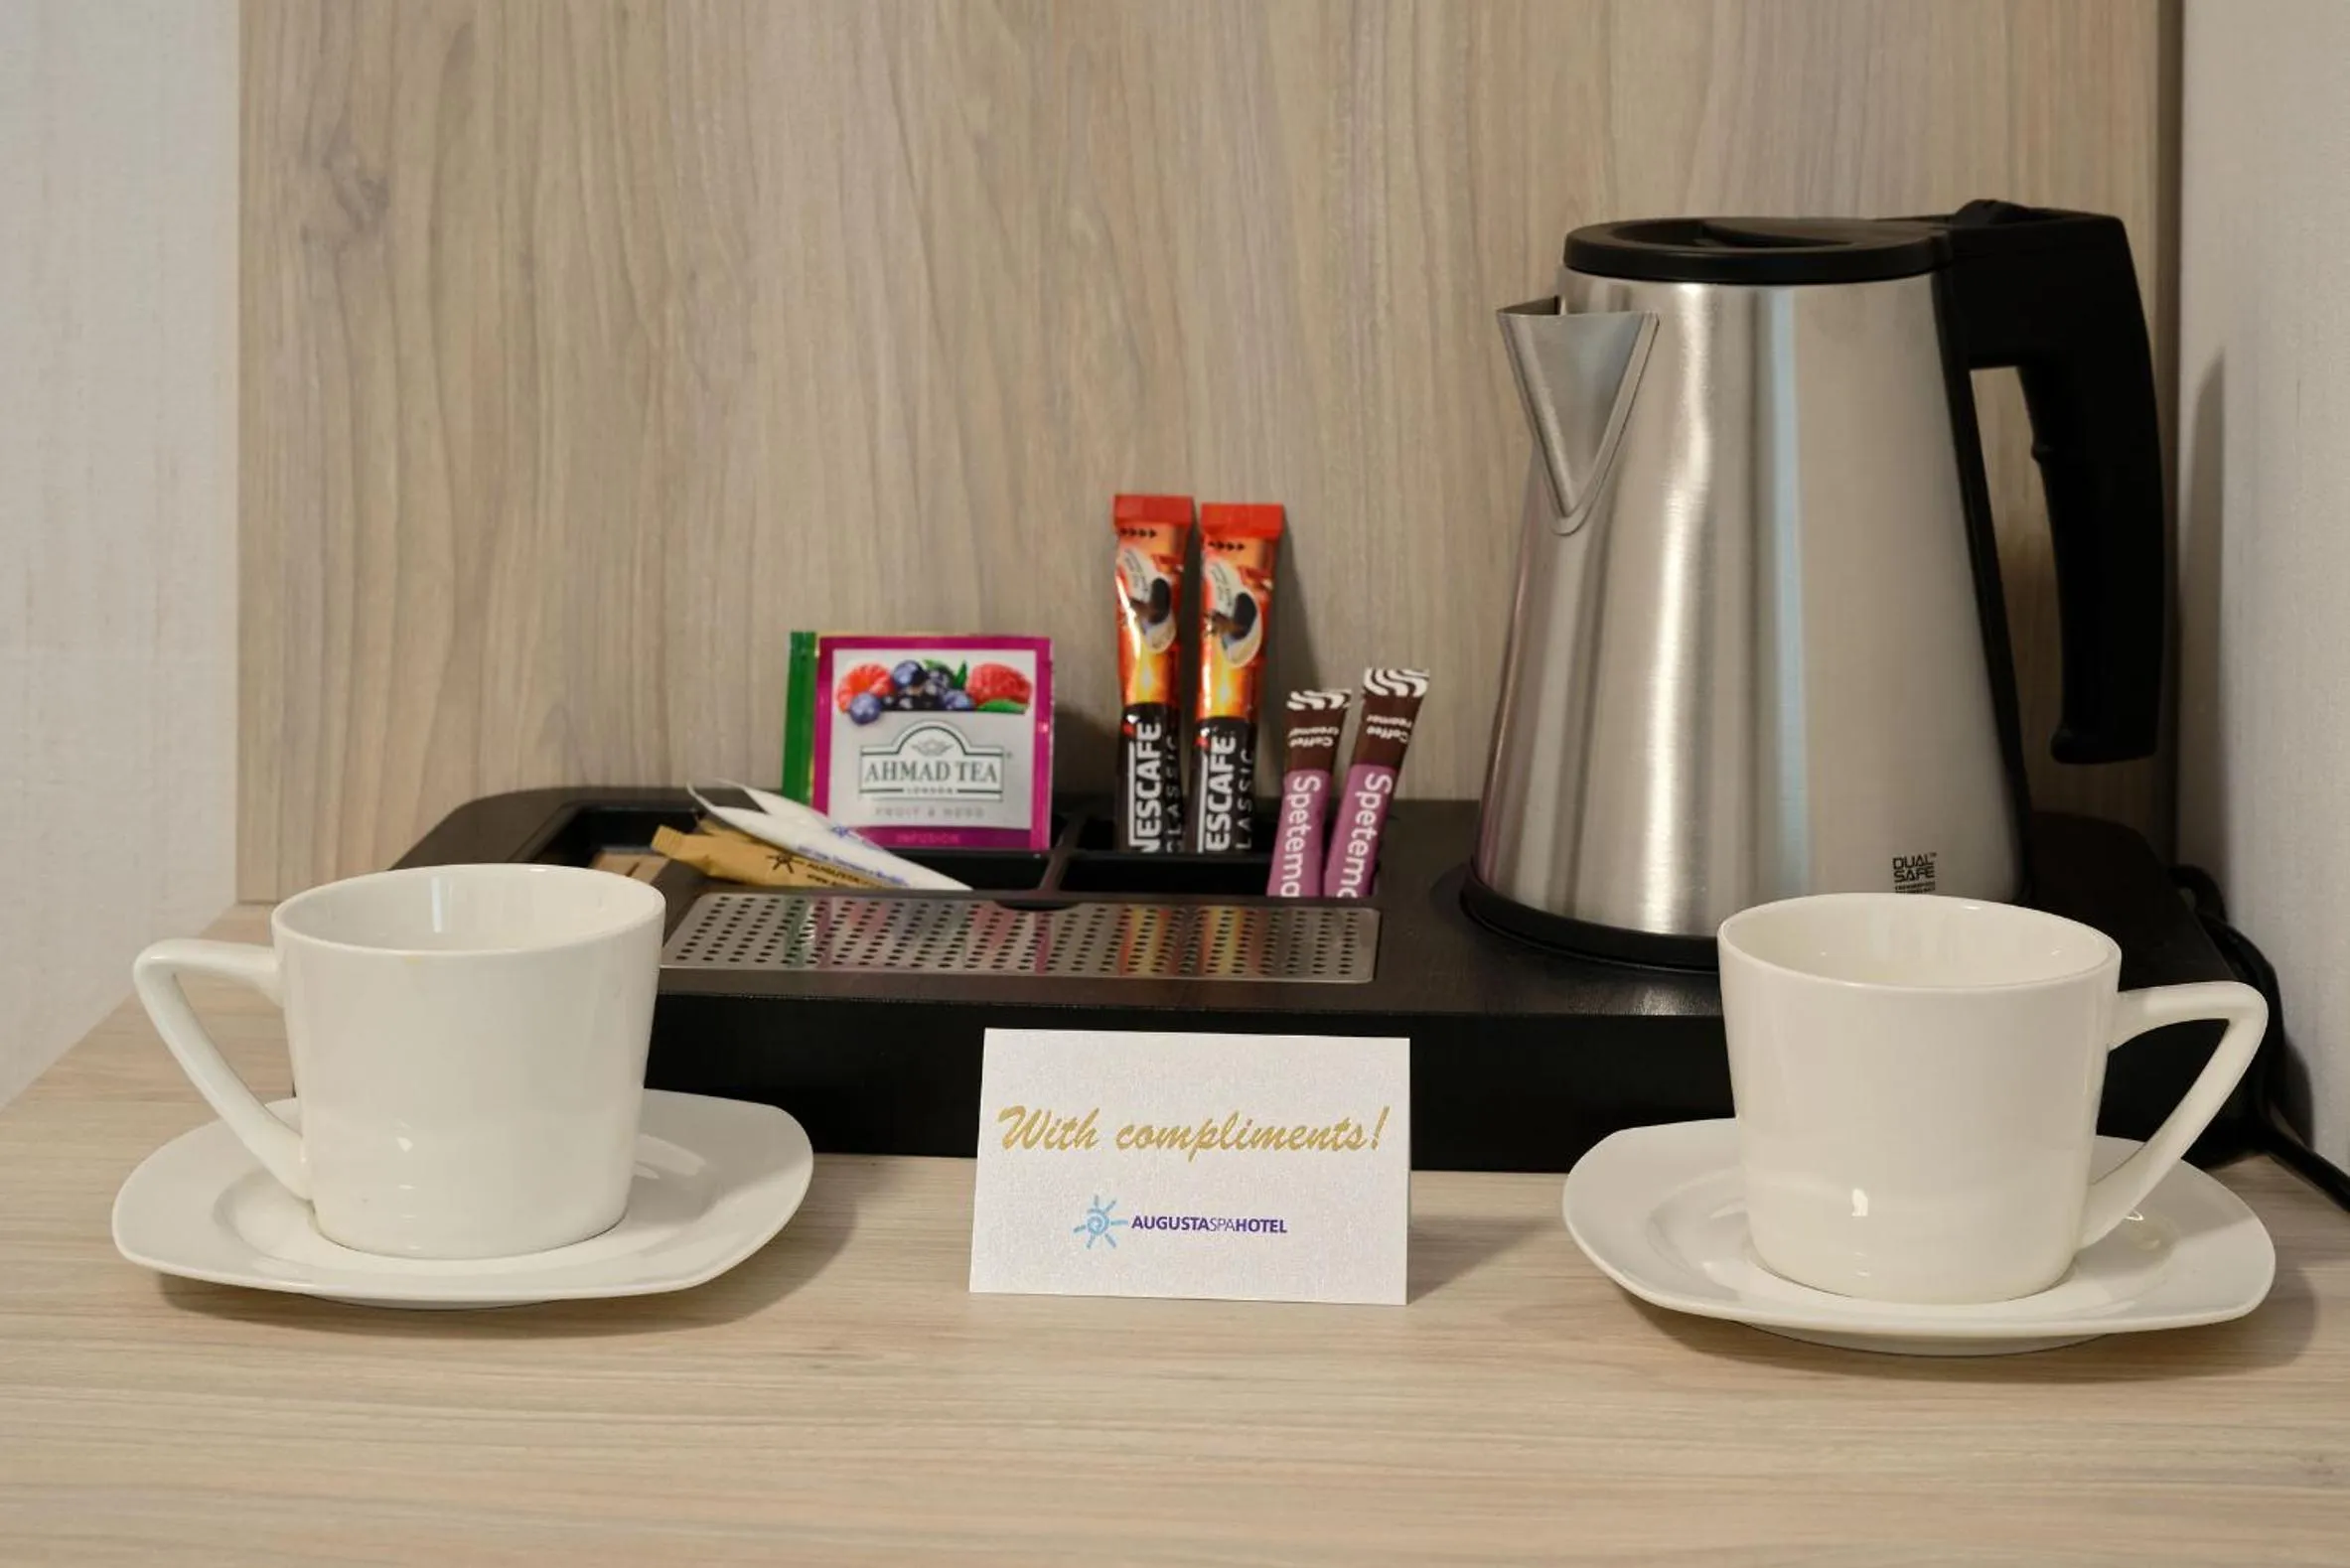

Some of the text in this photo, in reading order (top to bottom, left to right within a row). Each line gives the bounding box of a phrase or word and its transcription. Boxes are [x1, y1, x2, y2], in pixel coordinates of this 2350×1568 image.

[1366, 714, 1412, 728] reamer
[864, 761, 998, 783] AHMAD TEA
[1235, 749, 1252, 850] LASSIC
[1893, 865, 1935, 883] SAFE
[998, 1105, 1391, 1162] With compliments!
